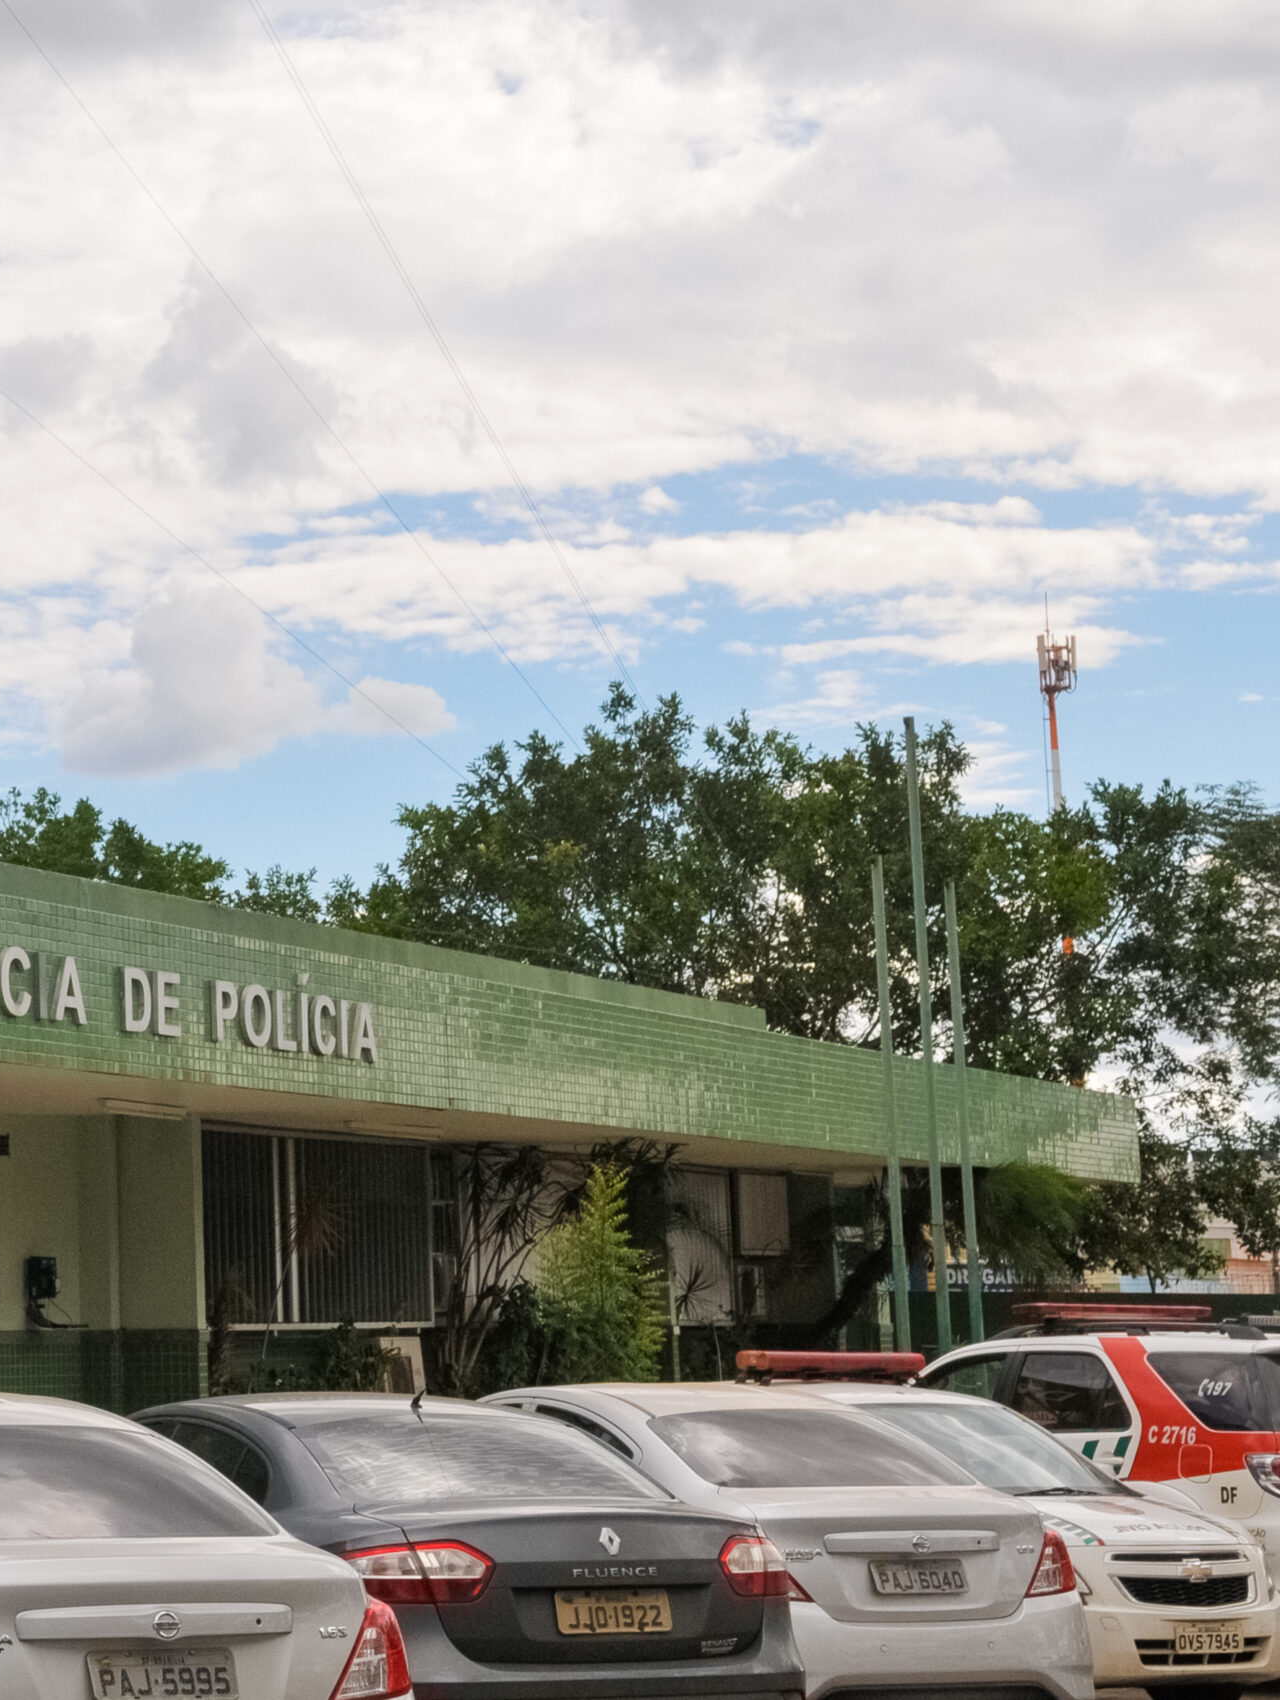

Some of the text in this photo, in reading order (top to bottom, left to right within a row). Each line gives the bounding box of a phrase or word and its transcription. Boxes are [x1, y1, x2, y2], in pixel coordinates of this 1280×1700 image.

[121, 966, 181, 1037] DE
[210, 973, 378, 1063] POLÍCIA
[1206, 1382, 1232, 1396] 197
[1148, 1425, 1196, 1445] C 2716
[1221, 1486, 1237, 1504] DF
[572, 1566, 659, 1578] FLUENCE
